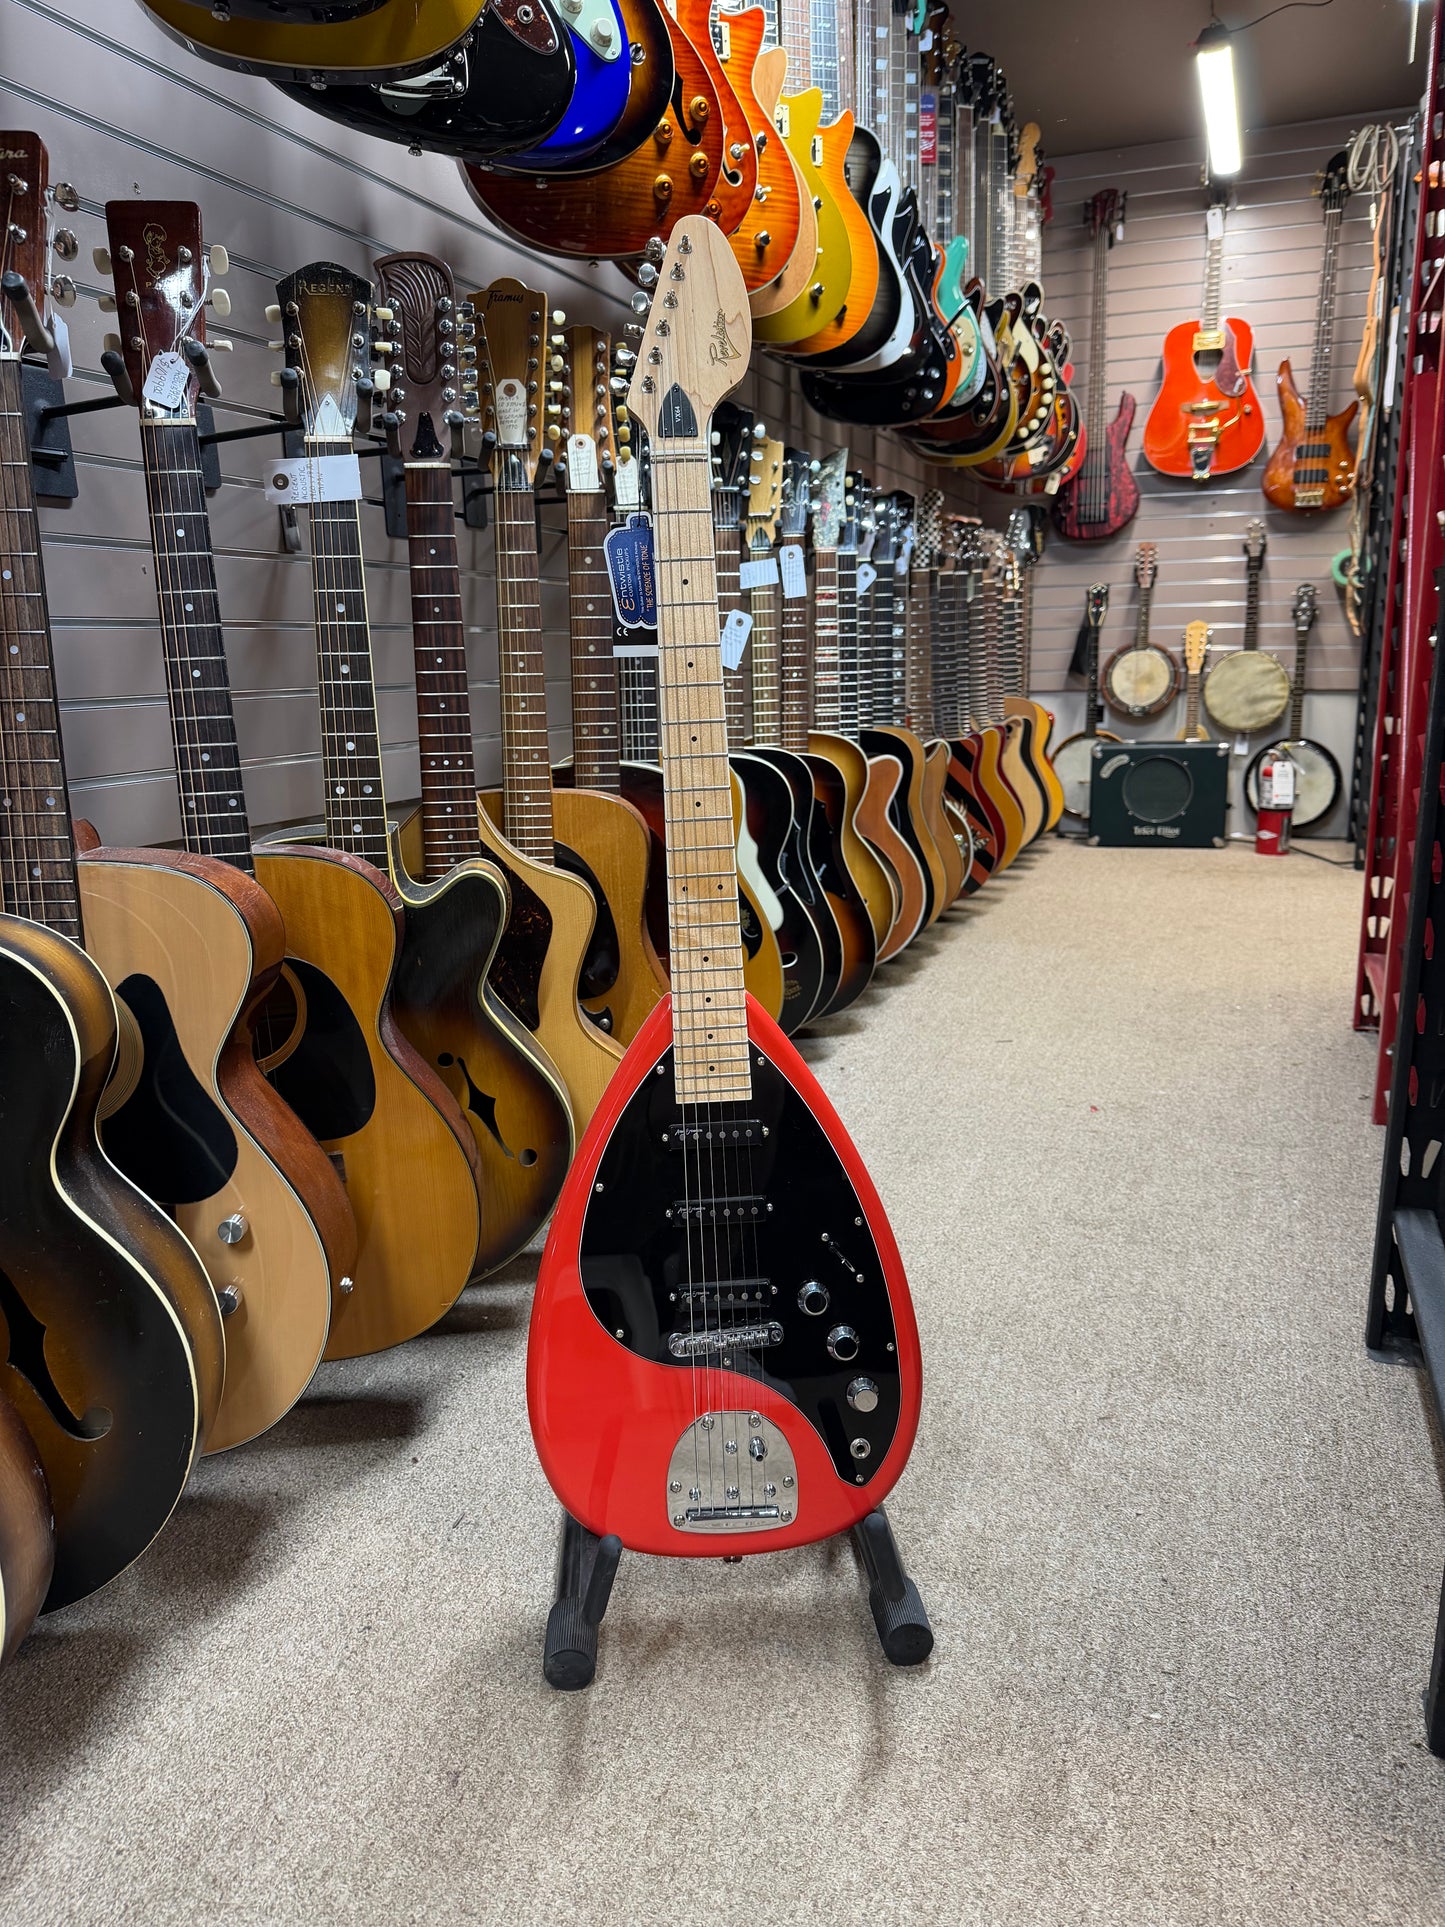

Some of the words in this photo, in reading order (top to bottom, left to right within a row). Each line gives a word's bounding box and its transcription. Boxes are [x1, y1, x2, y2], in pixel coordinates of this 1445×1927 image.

[487, 290, 524, 310] Framus
[298, 465, 308, 500] ACOUSTIC
[623, 547, 631, 571] PICKUPS
[642, 560, 650, 570] OF
[616, 547, 636, 611] Entwistle
[643, 571, 653, 597] SCIENCE
